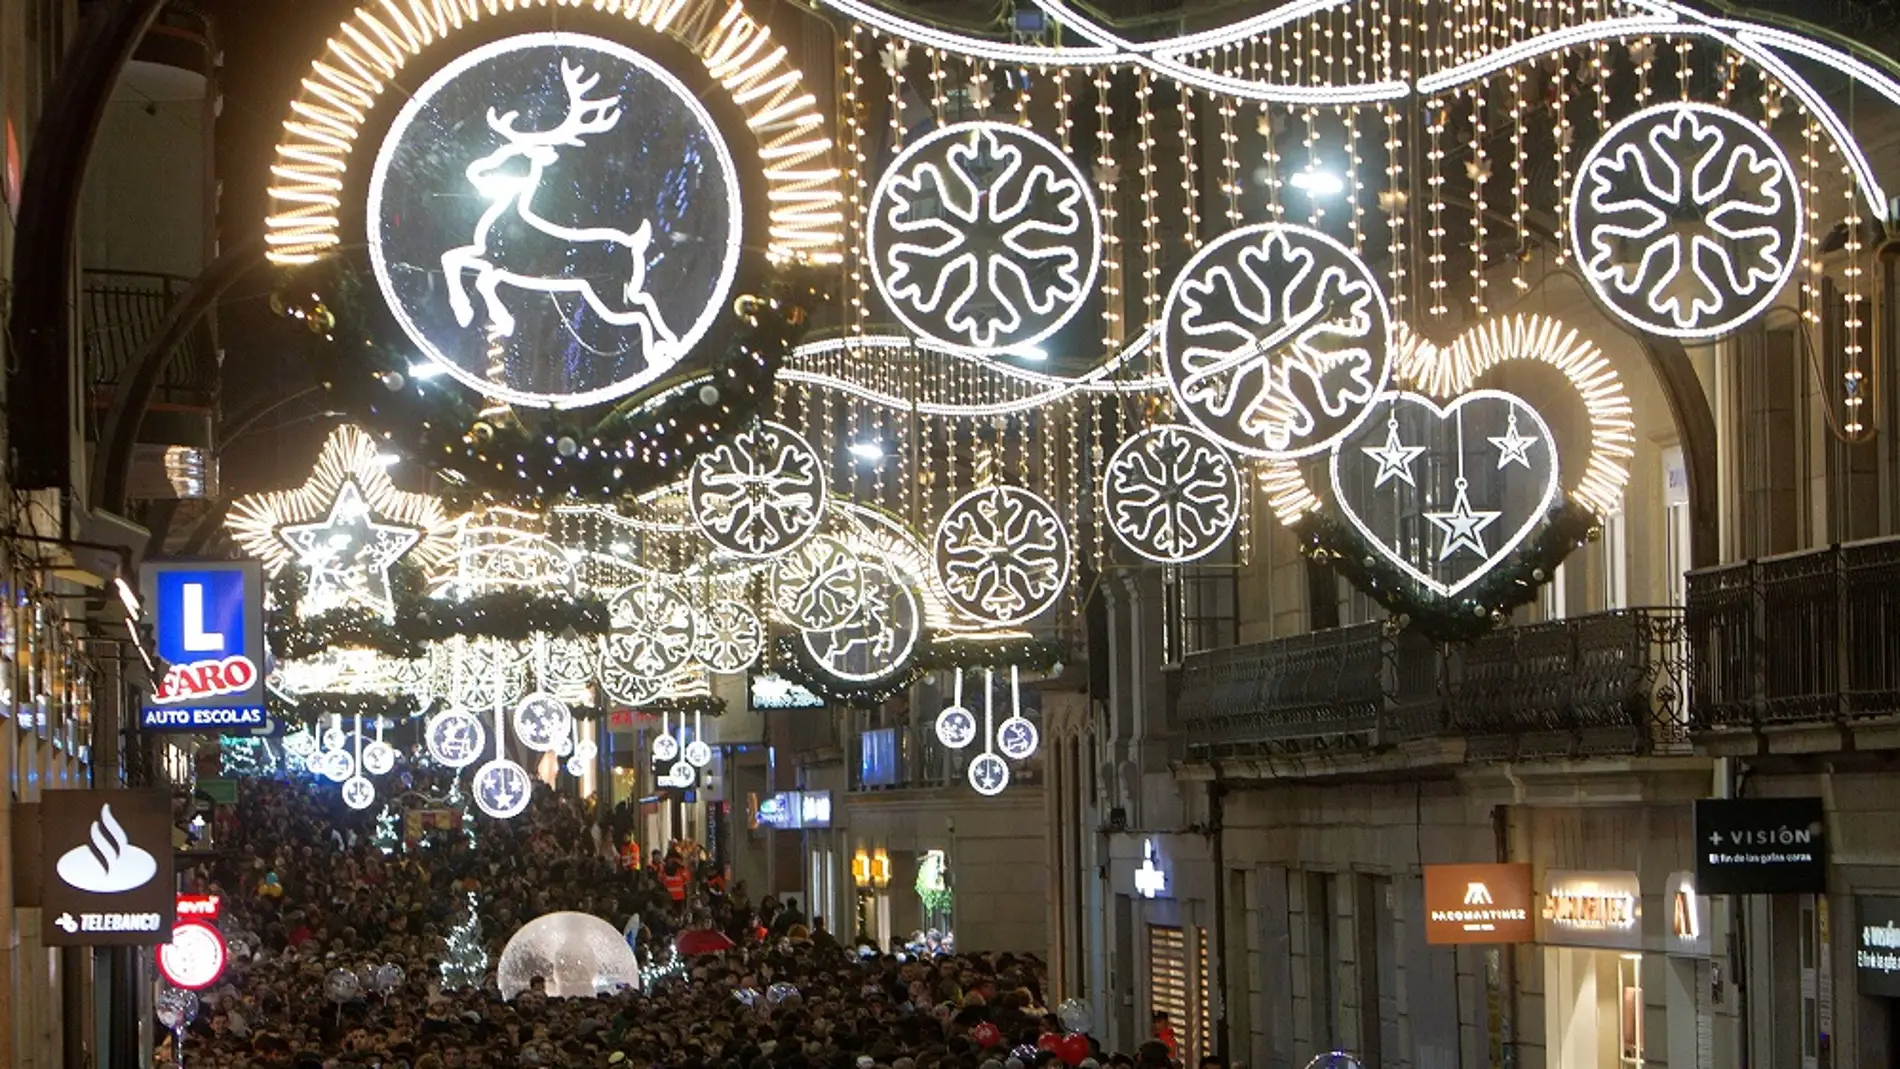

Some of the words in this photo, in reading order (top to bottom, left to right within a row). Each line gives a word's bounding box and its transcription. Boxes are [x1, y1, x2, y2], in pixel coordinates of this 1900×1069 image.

[182, 583, 224, 652] L
[157, 660, 252, 699] FARO
[145, 709, 189, 724] AUTO
[193, 708, 261, 723] ESCOLAS
[1730, 824, 1811, 845] VISIÓN
[80, 912, 161, 932] TELEBANCO
